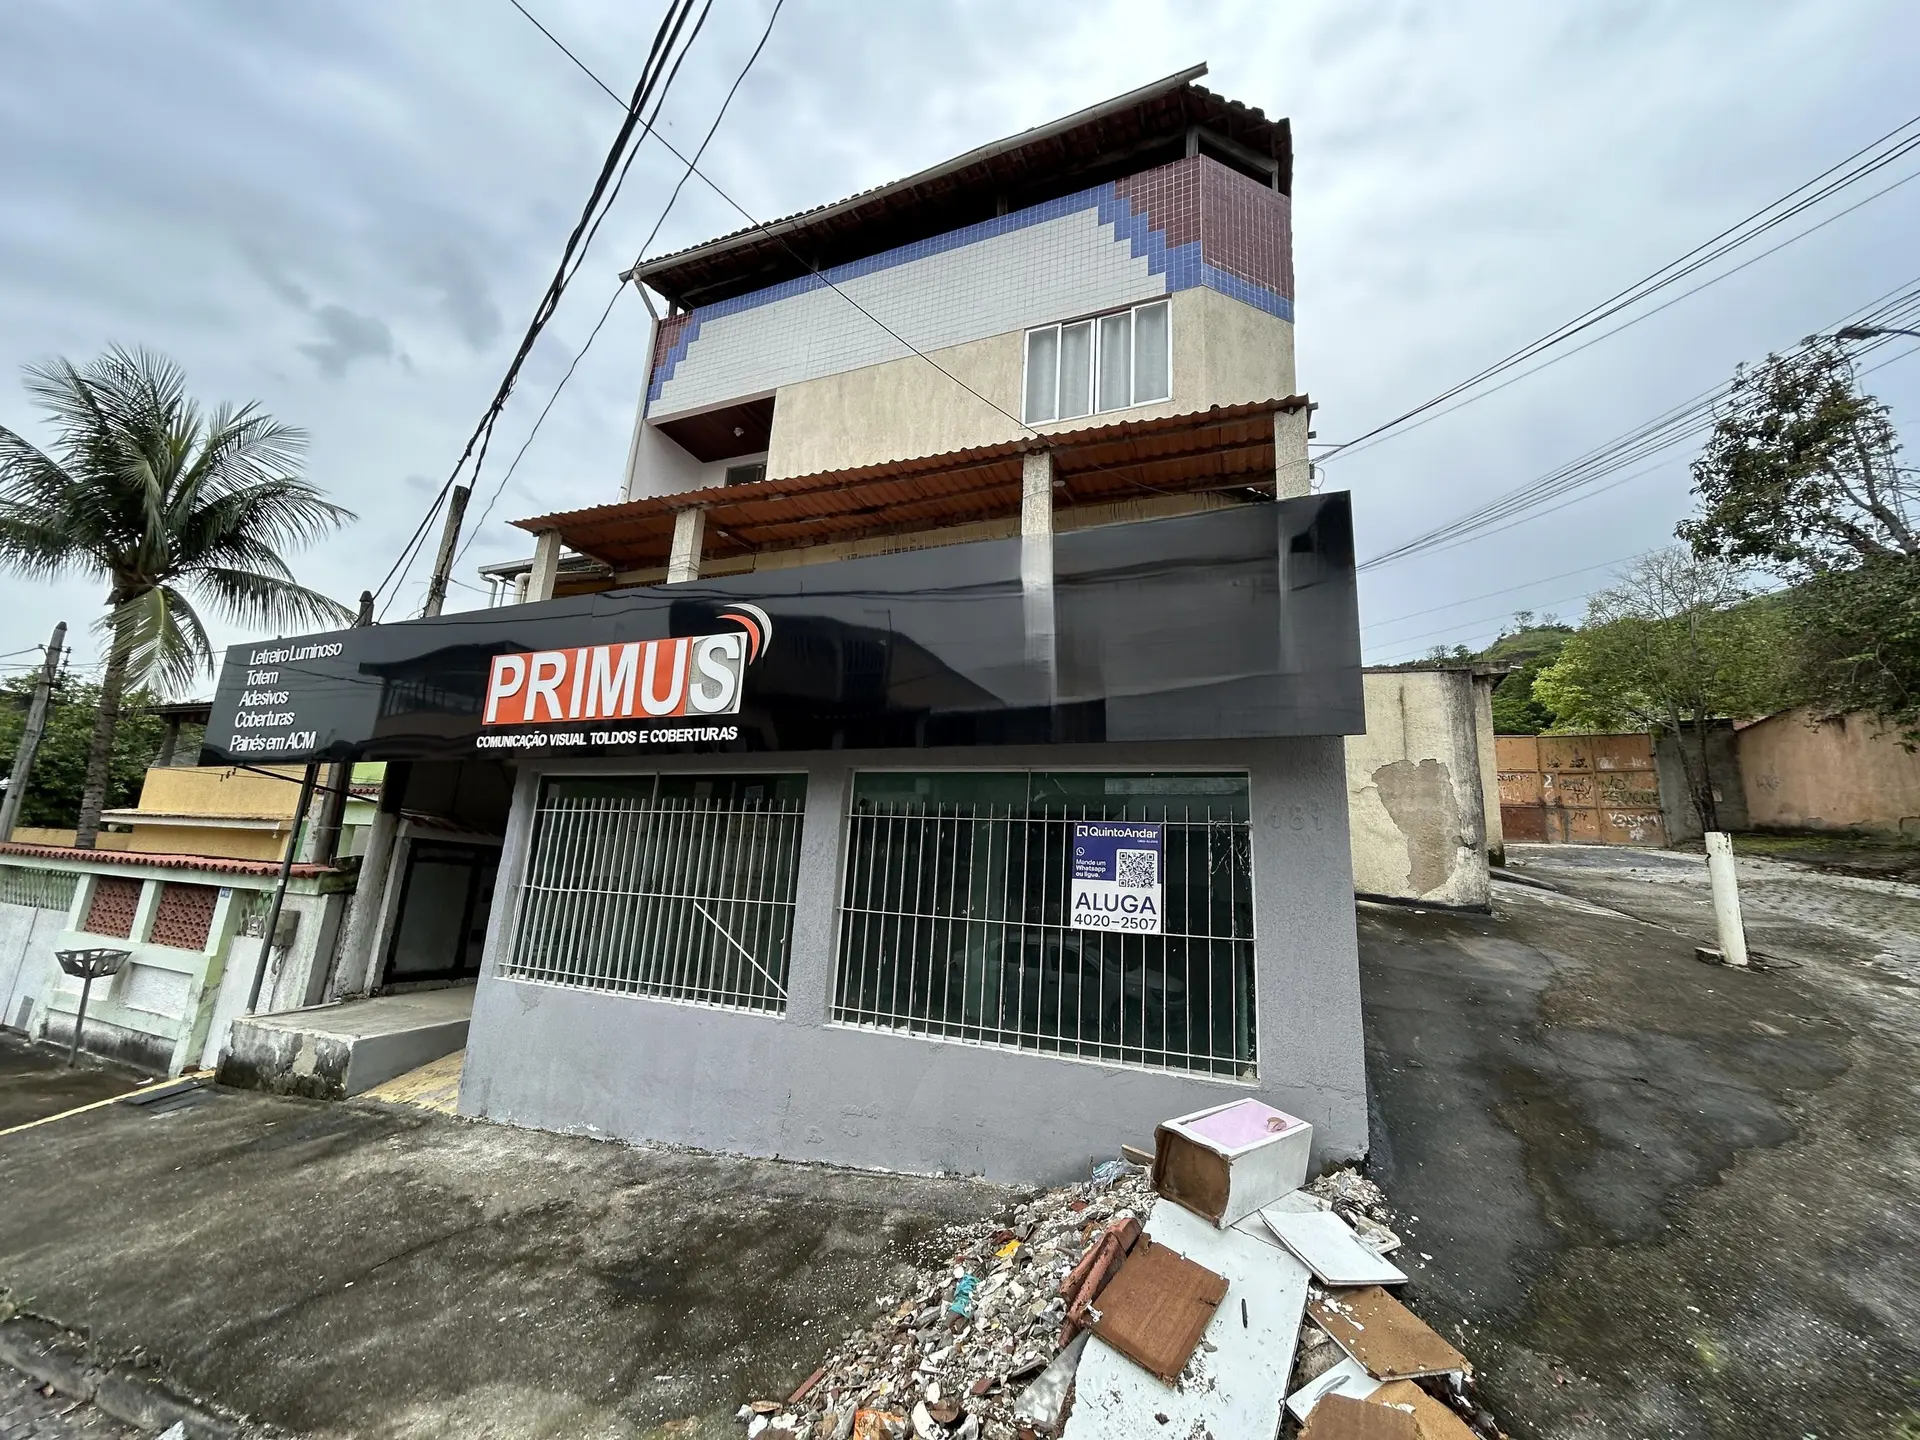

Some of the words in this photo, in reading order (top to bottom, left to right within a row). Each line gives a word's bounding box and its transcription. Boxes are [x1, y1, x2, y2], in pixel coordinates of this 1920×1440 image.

[249, 648, 290, 666] Letreiro
[289, 642, 343, 662] Luminoso
[246, 669, 279, 686] Totem
[485, 634, 740, 722] PRIMUS
[238, 689, 290, 707] Adesivos
[234, 710, 296, 728] Coberturas
[266, 736, 286, 751] em
[284, 731, 317, 750] ACM
[476, 730, 548, 749] COMUNICAÇÃO
[550, 732, 587, 747] VISUAL
[590, 730, 637, 745] TOLDOS
[639, 730, 648, 744] E
[650, 726, 739, 743] COBERTURAS
[1089, 827, 1158, 839] QuintoAndar
[1075, 858, 1096, 866] Mande
[1075, 891, 1157, 915] ALUGA
[1074, 913, 1157, 931] 4020-2507
